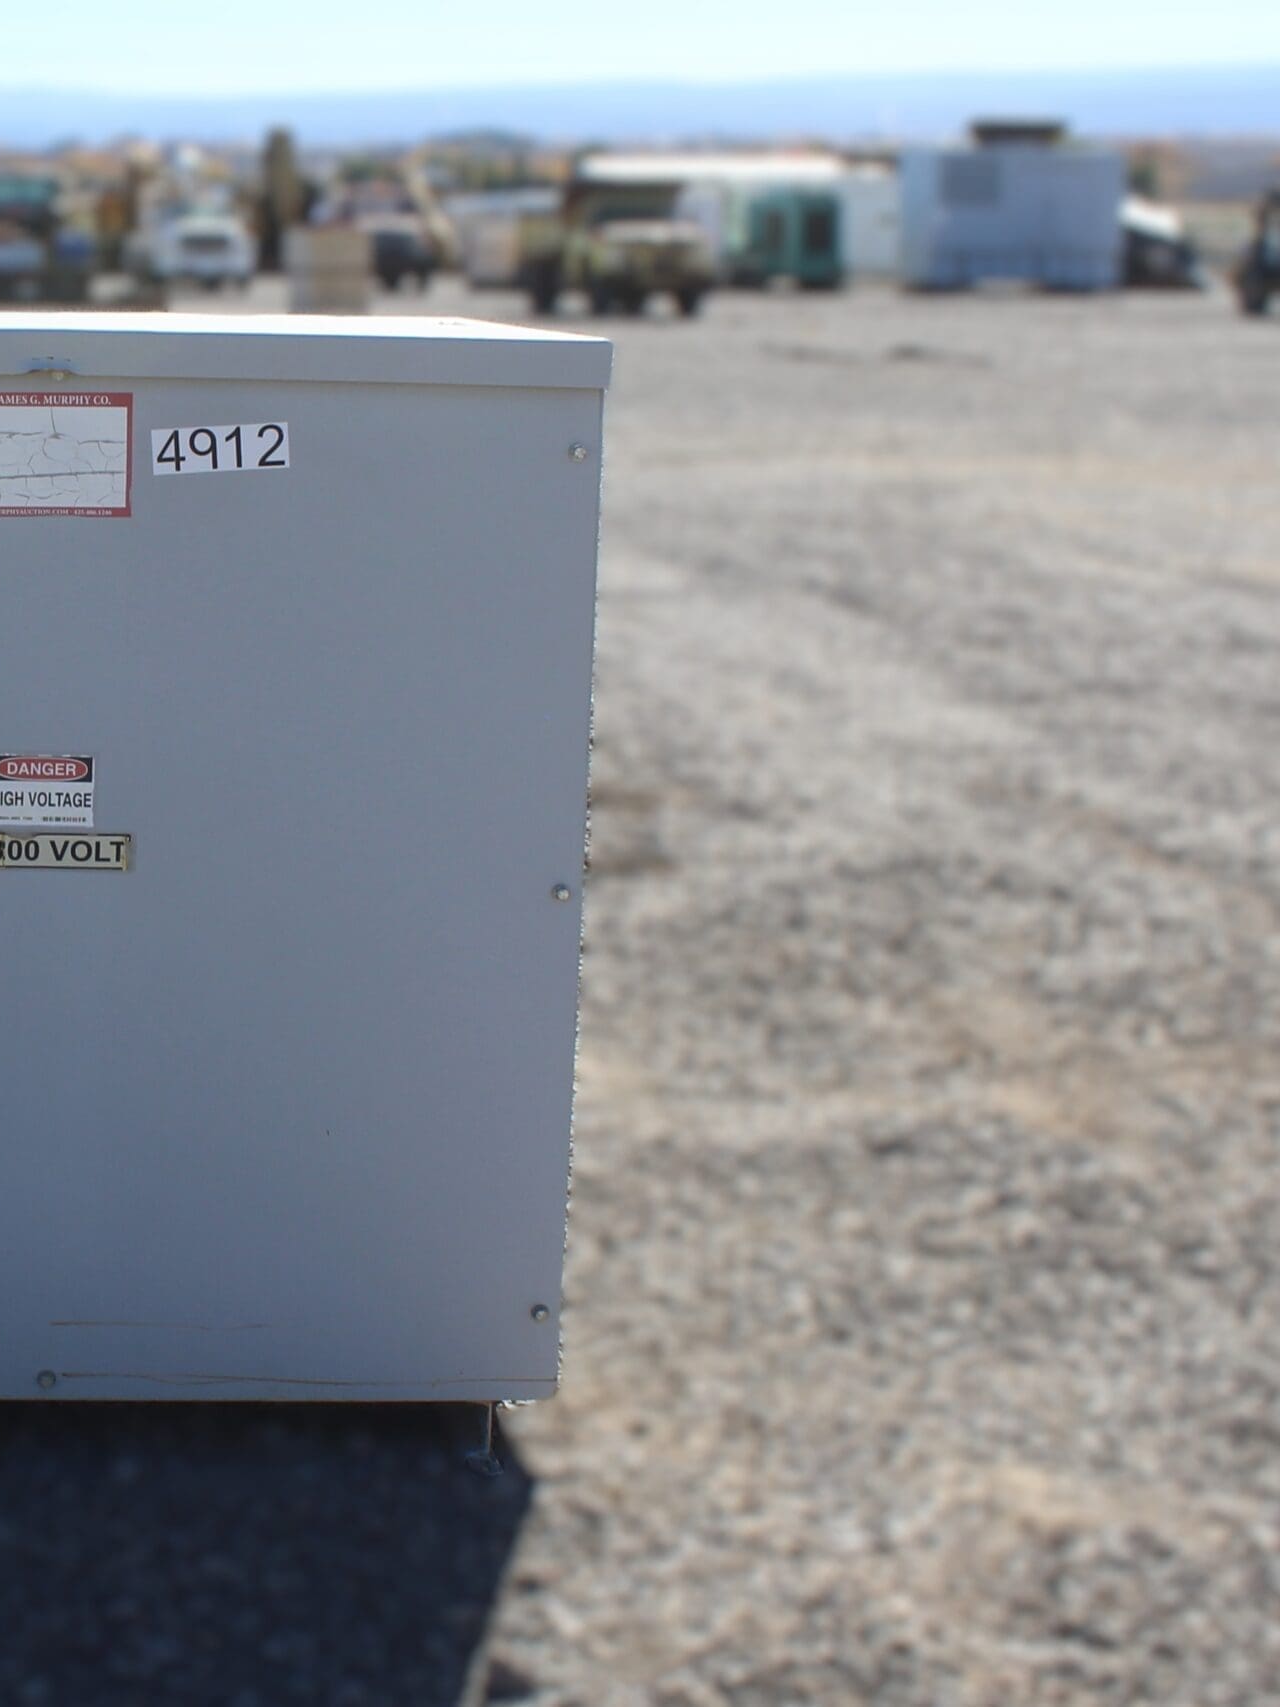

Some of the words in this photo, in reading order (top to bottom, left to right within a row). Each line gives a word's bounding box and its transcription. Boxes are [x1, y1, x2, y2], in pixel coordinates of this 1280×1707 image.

[29, 394, 41, 406] G.
[43, 394, 92, 406] MURPHY
[93, 394, 112, 406] CO.
[156, 424, 286, 472] 4912
[6, 761, 77, 777] DANGER
[28, 791, 92, 809] VOLTAGE
[49, 839, 125, 863] VOLT
